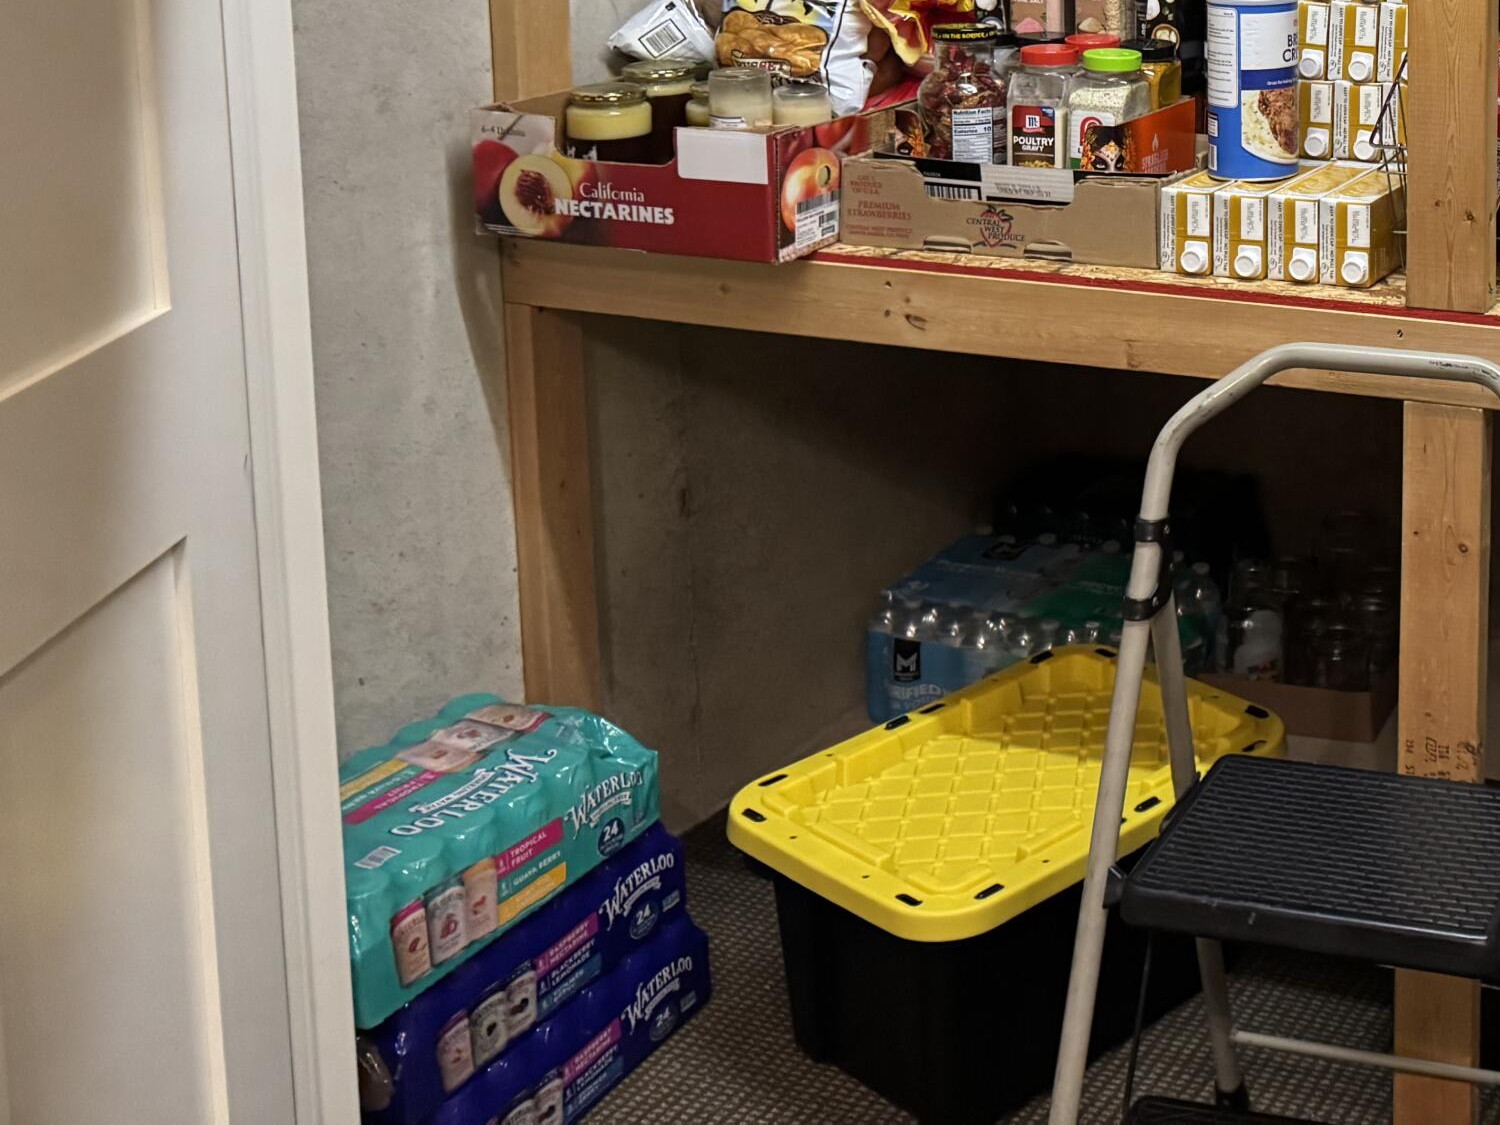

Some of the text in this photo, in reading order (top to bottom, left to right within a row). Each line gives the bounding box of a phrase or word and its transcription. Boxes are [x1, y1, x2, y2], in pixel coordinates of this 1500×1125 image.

[1013, 136, 1055, 147] POULTRY
[579, 181, 645, 203] California
[554, 198, 675, 225] NECTARINES
[858, 200, 900, 211] PREMIUM
[966, 217, 1001, 227] CENTRAL
[984, 225, 1005, 234] WEST
[987, 232, 1026, 242] PRODUCE
[391, 748, 558, 836] WATERLOO
[563, 771, 644, 841] WATERLOO
[603, 821, 620, 842] 24
[509, 830, 548, 857] TROPICAL
[511, 848, 534, 867] FRUIT
[538, 850, 562, 867] BERRY
[598, 852, 675, 931] WATERLOO
[635, 903, 651, 925] 24
[551, 938, 596, 977] BLACKBERRY
[552, 951, 591, 986] LEMONADE
[620, 955, 693, 1036] WATERLOO
[654, 1006, 670, 1027] 24
